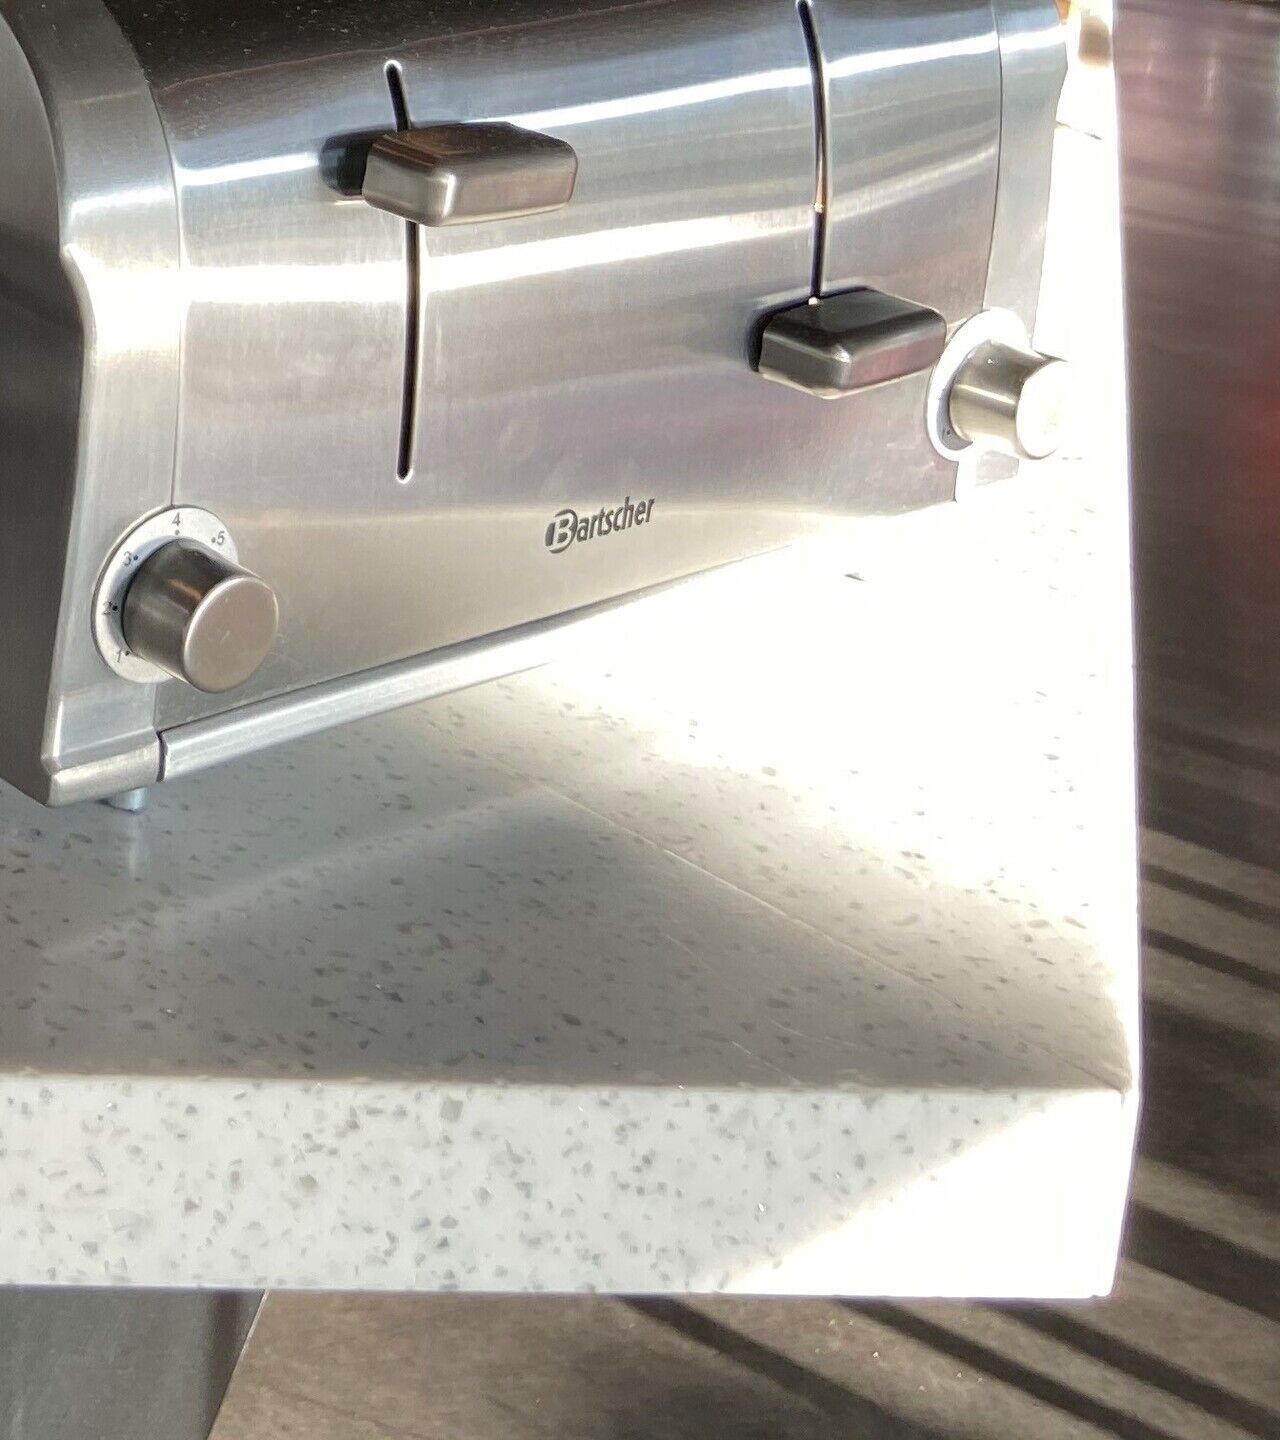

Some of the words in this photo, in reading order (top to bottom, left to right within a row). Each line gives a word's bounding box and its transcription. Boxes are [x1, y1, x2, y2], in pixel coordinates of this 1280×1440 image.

[172, 512, 181, 527] 4
[544, 495, 655, 554] Bartscher
[216, 530, 225, 546] 5
[122, 550, 132, 566] 3
